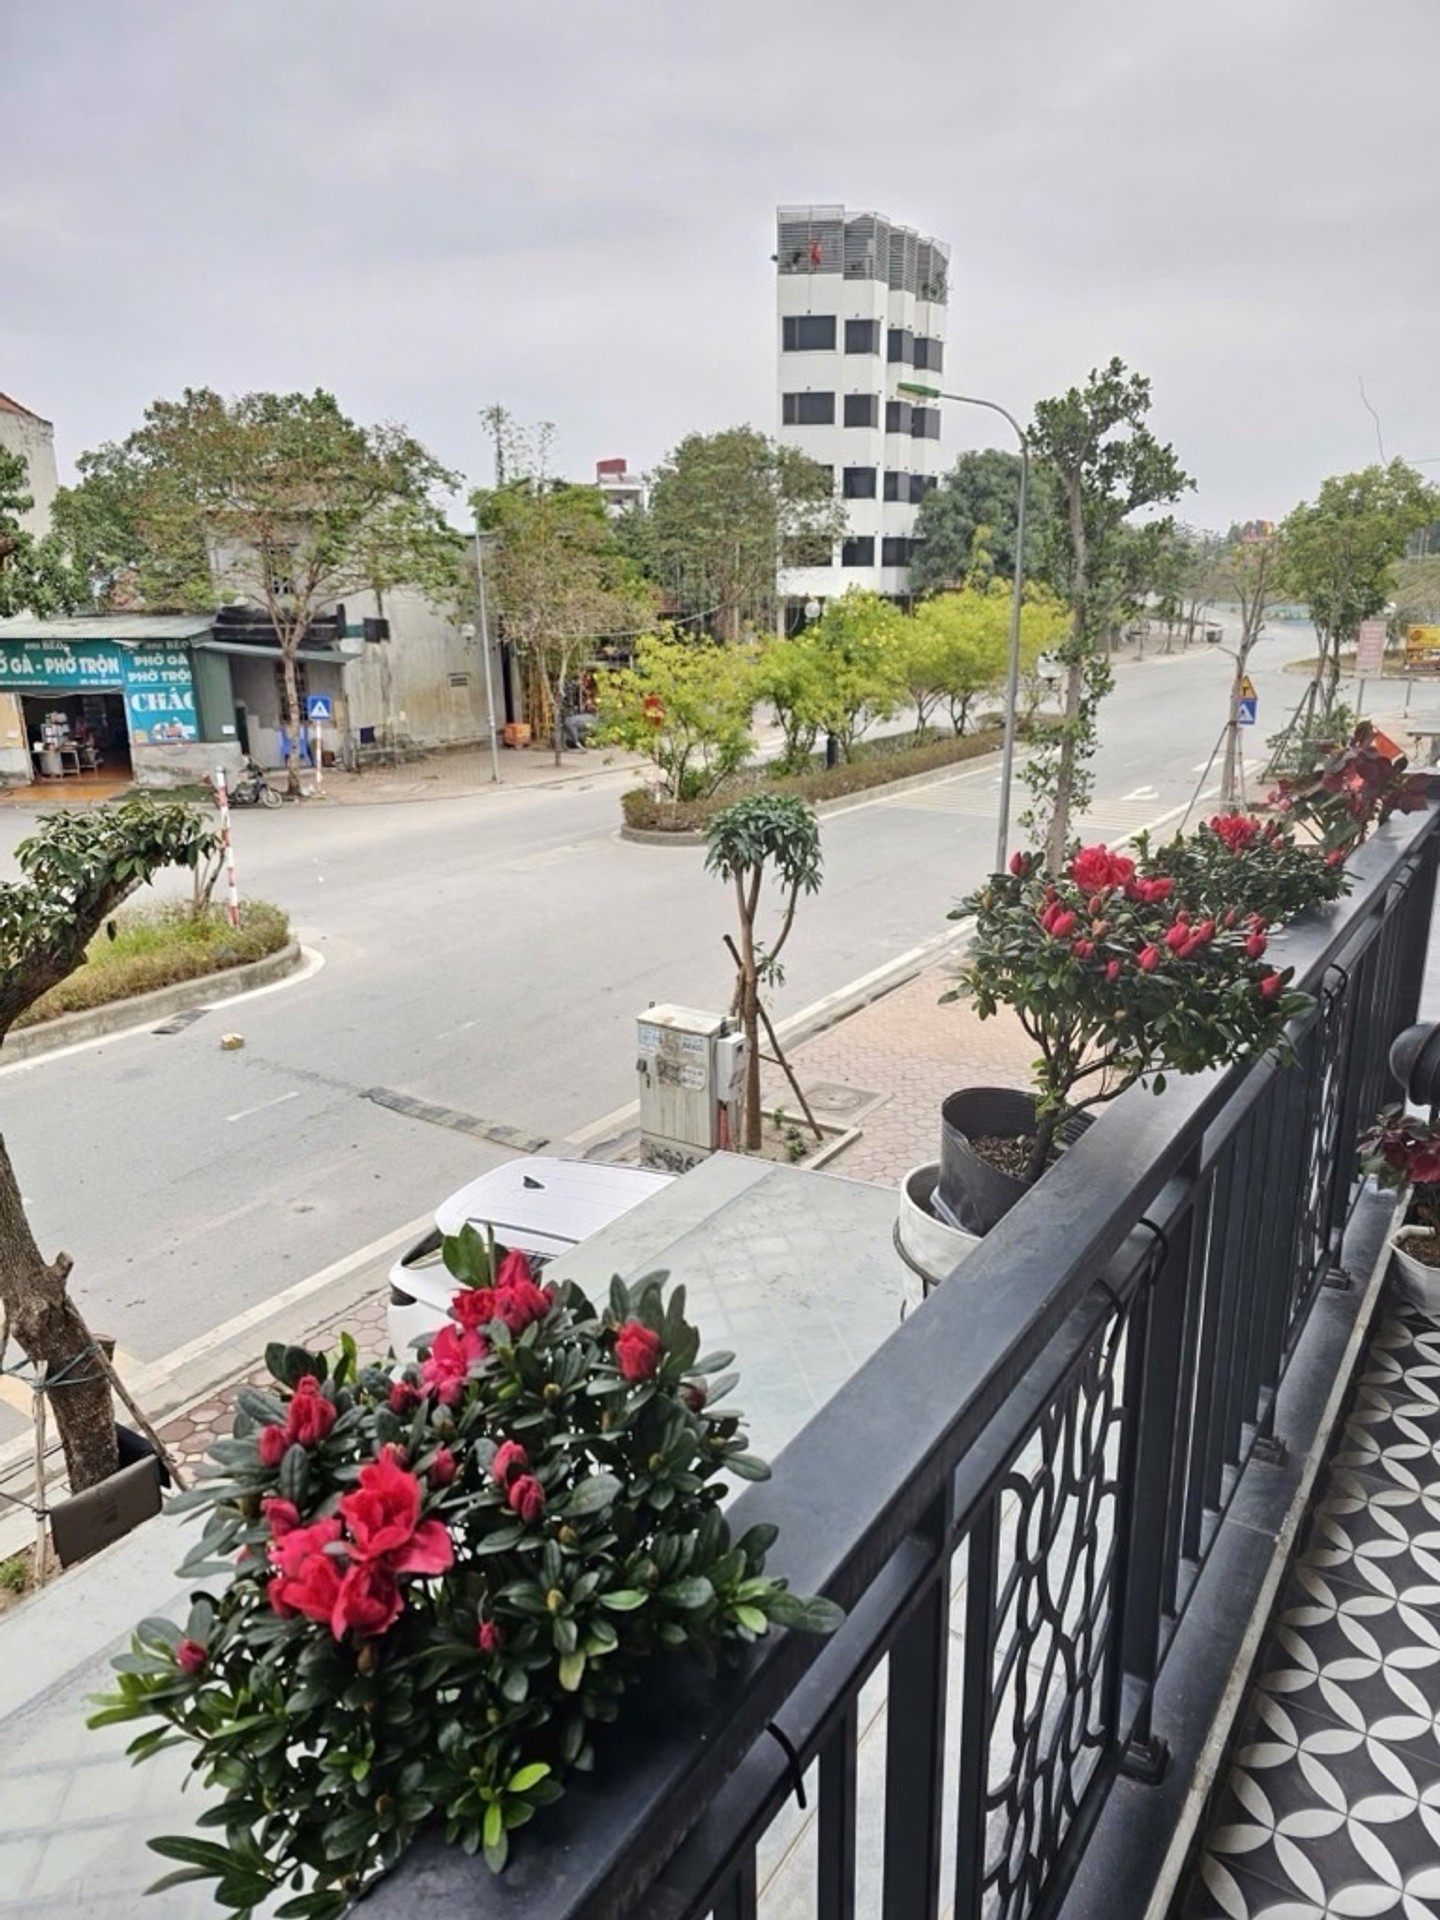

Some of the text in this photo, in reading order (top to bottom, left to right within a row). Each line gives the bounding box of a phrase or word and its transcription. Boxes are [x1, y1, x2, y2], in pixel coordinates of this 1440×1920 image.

[10, 653, 34, 674] GÀ
[44, 646, 77, 674] PHỞ
[79, 653, 120, 678] TRỘN
[133, 652, 164, 667] PHỞ
[128, 668, 159, 682] PHỞ
